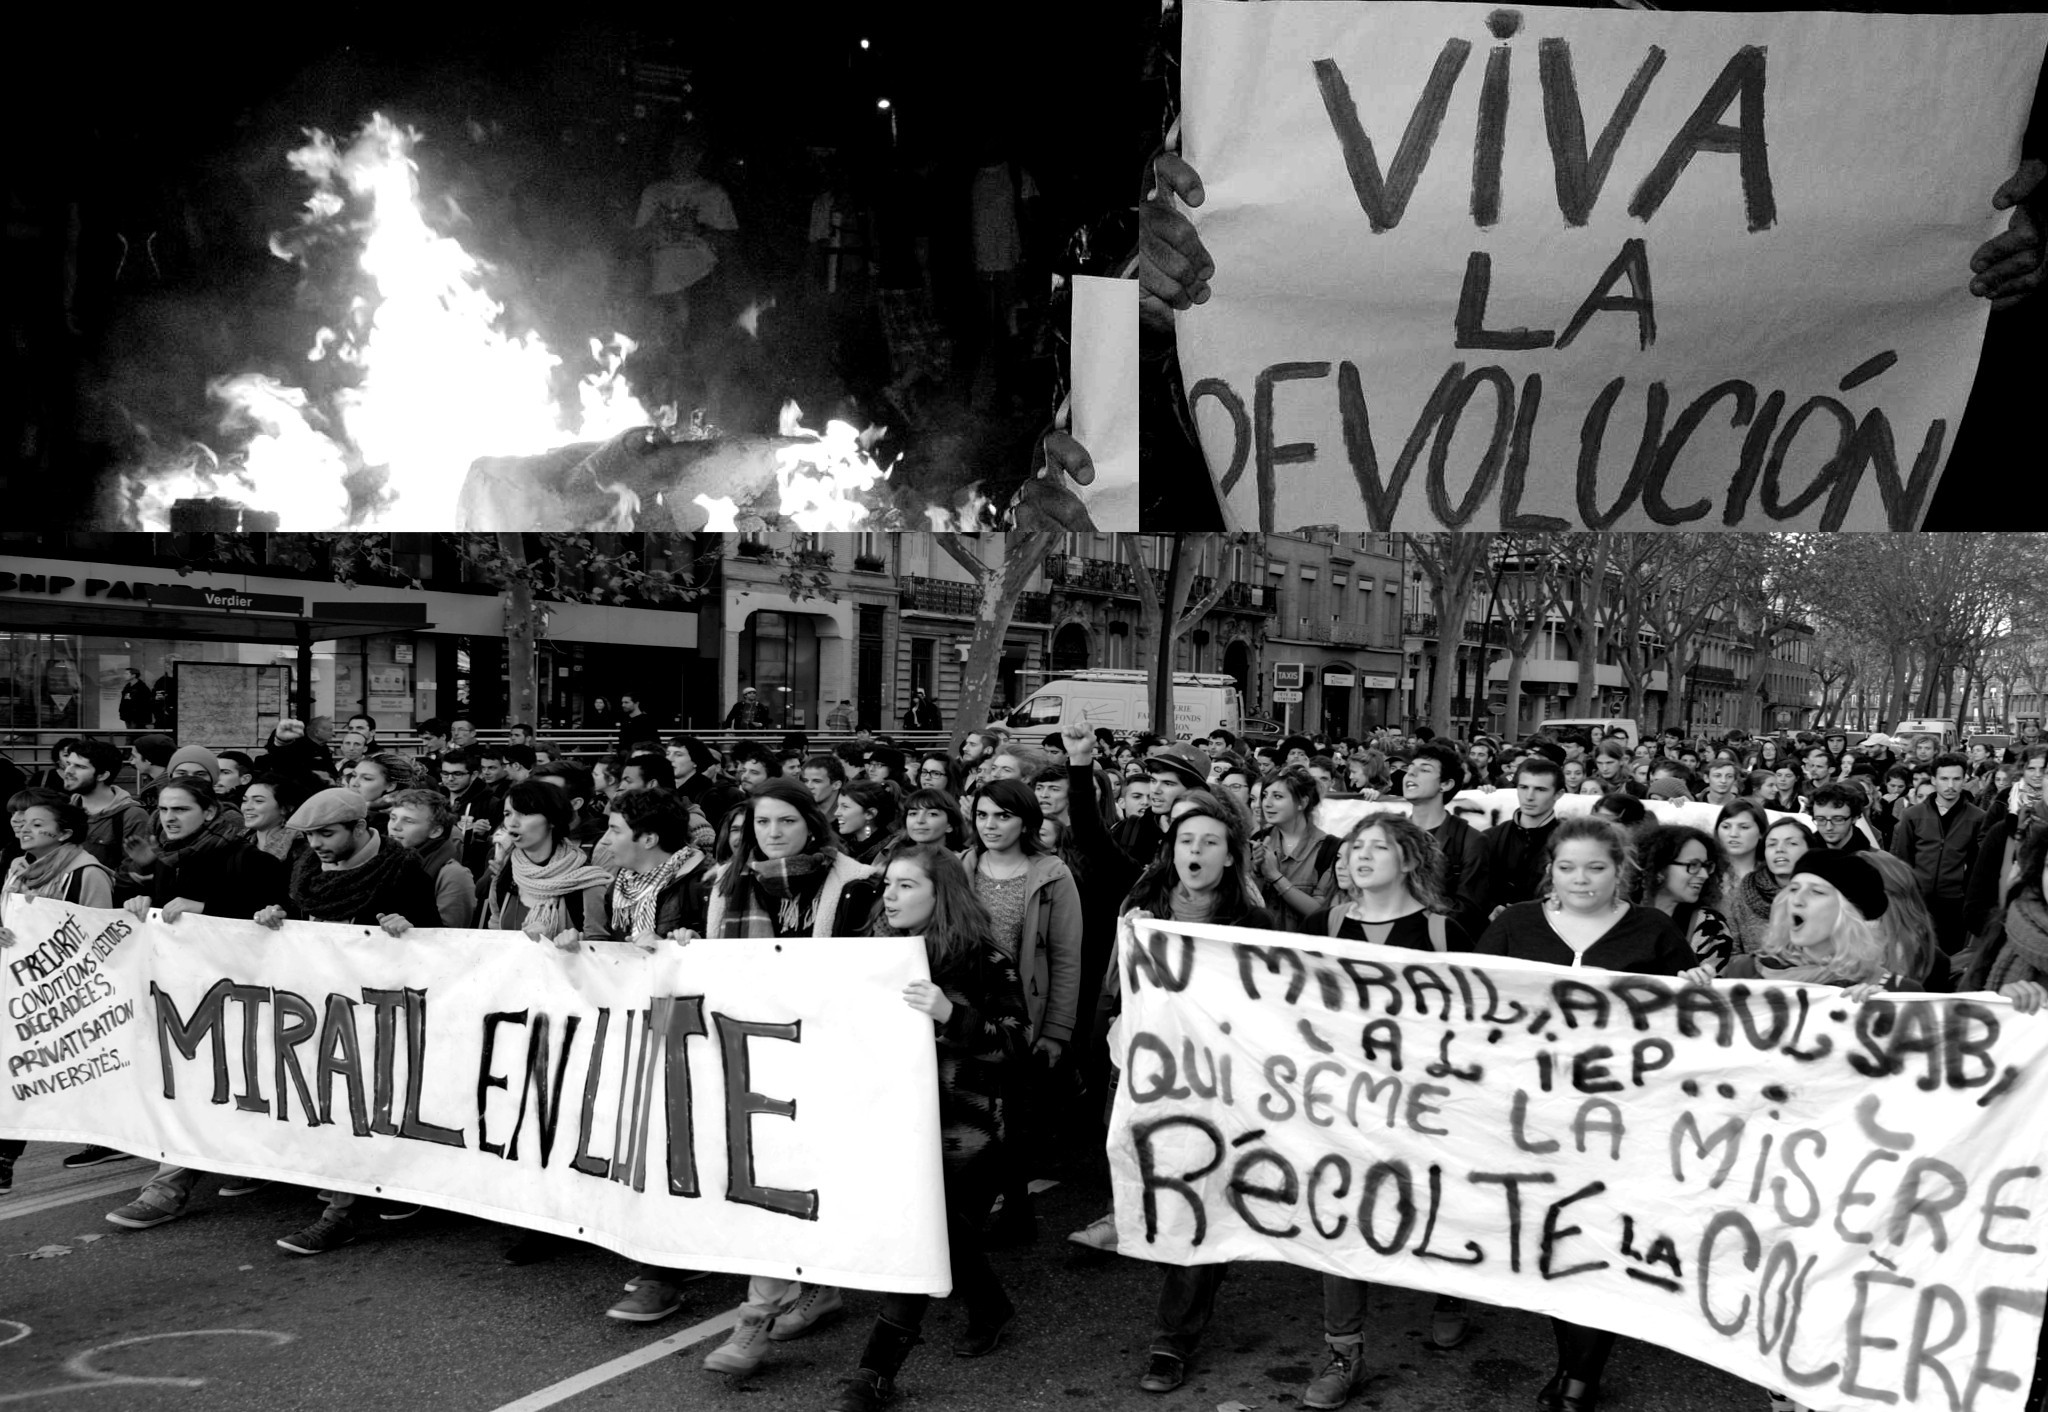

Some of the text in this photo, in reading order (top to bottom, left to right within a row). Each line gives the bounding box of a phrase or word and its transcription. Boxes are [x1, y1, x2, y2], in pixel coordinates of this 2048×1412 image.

[1453, 238, 1657, 351] LA
[205, 593, 253, 607] Verdier
[1278, 671, 1298, 680] TAXIS
[150, 977, 819, 1222] MIRAIL EN LUTTE
[1510, 1088, 1627, 1161] LA
[1619, 1212, 1683, 1280] LA
